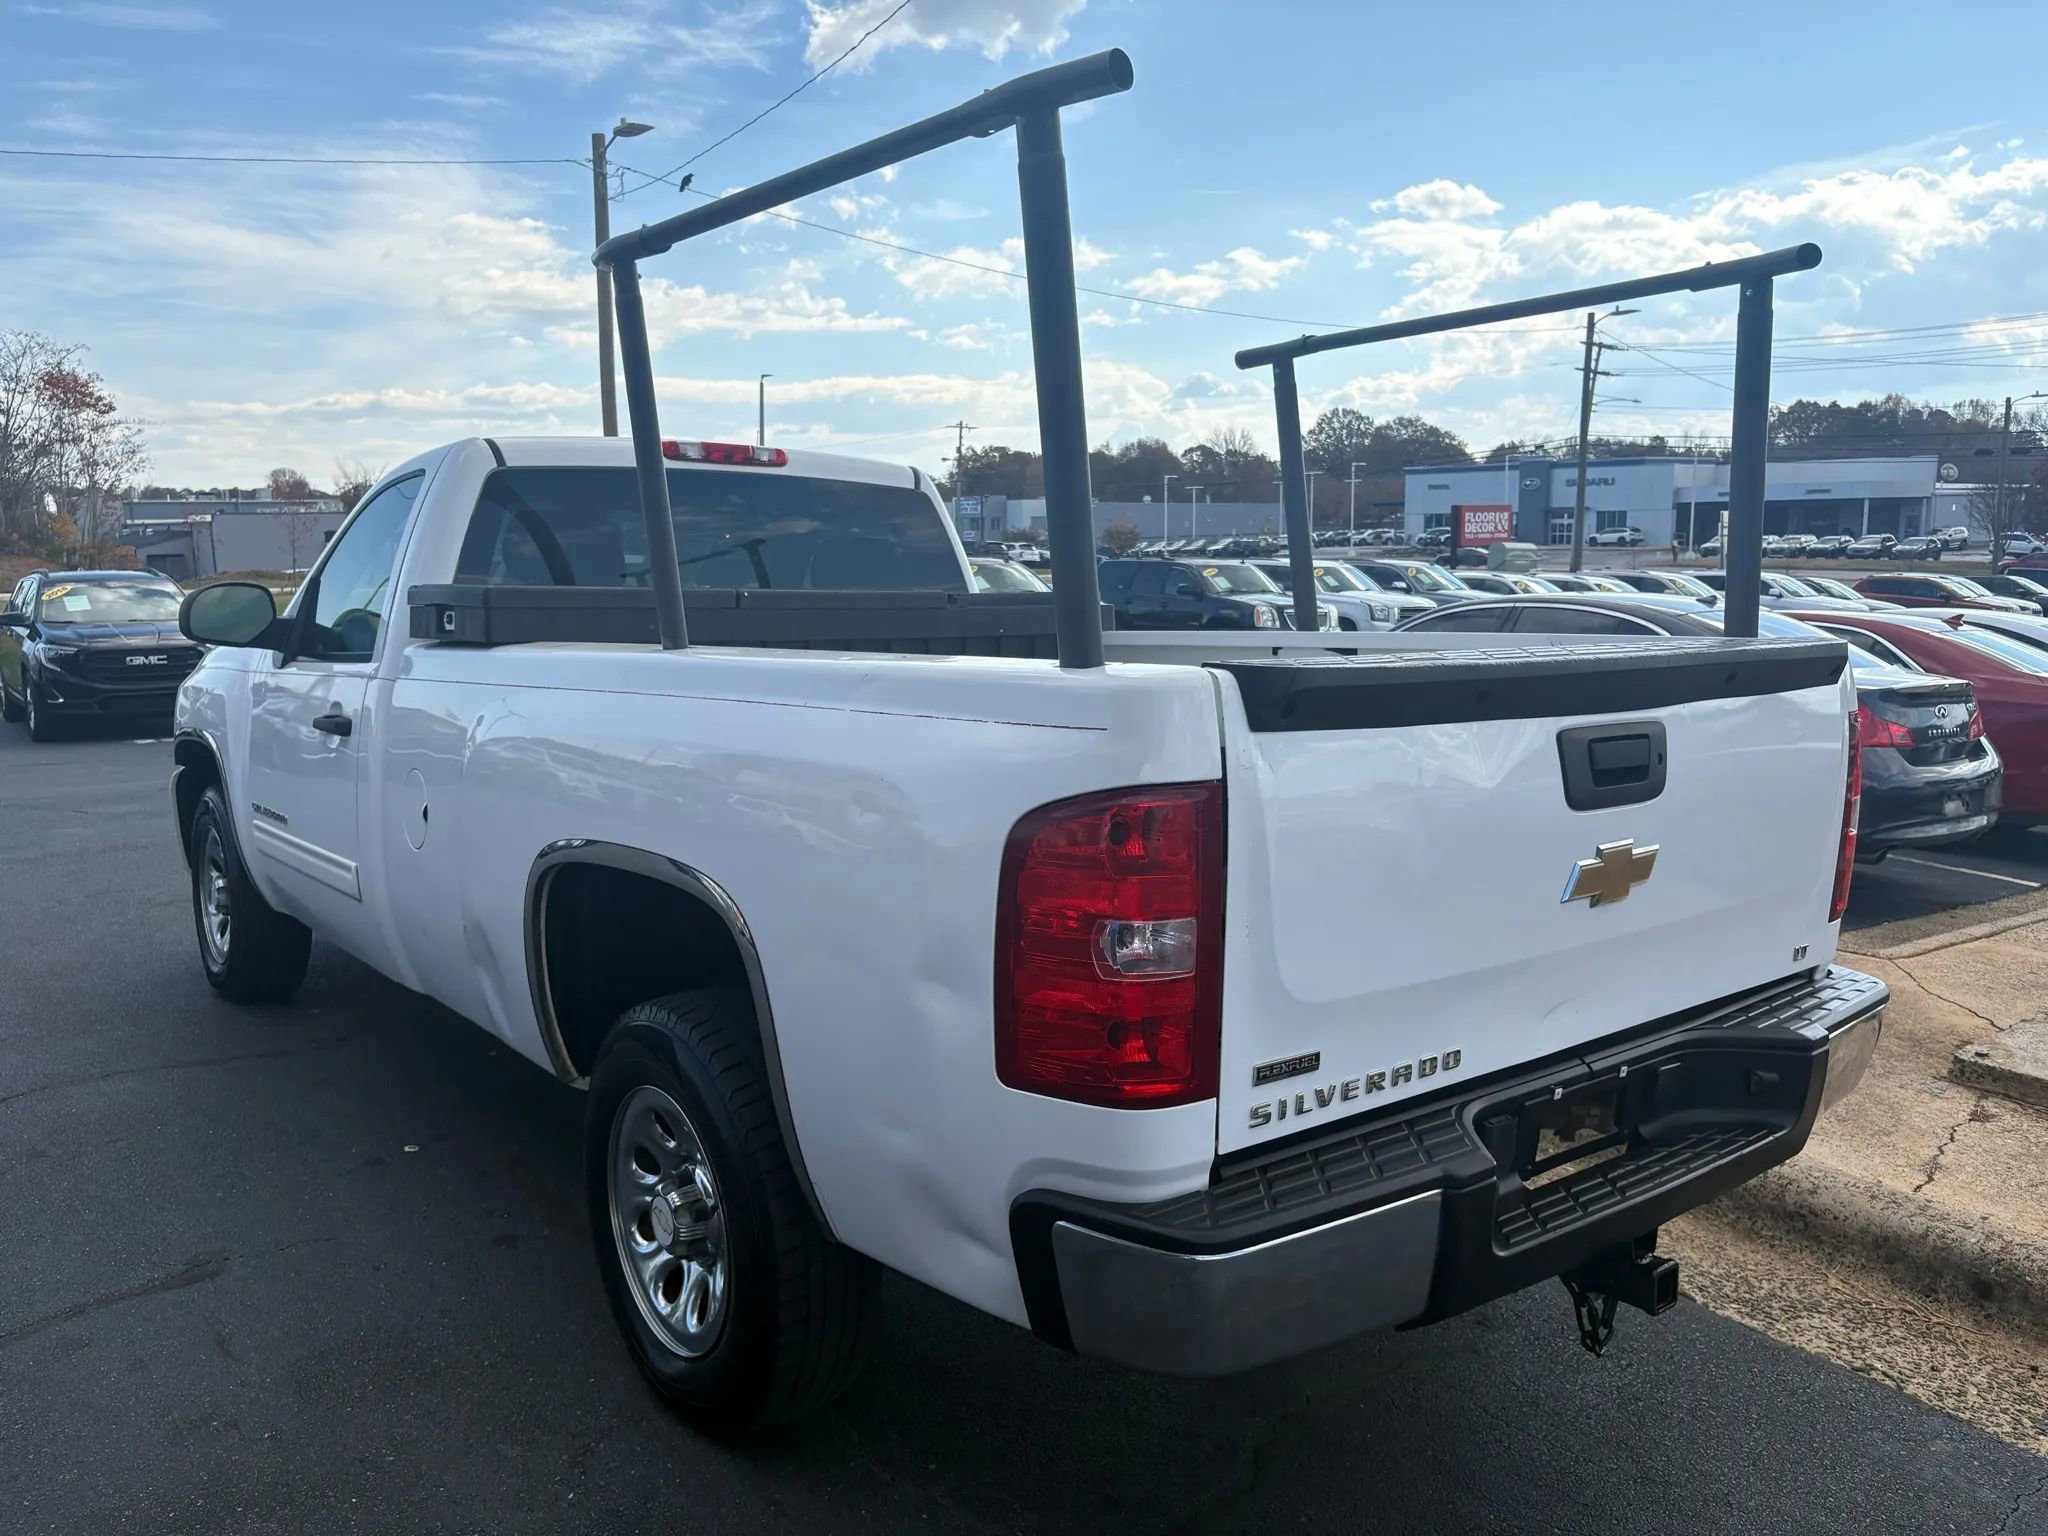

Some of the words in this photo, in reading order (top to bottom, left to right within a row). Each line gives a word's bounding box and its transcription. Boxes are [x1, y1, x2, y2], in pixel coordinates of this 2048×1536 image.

[1465, 512, 1496, 522] FLOOR
[1465, 522, 1496, 533] DECOR
[126, 655, 167, 665] GMC
[1258, 1053, 1320, 1080] FLEXFUEL
[1249, 1048, 1462, 1129] SILVERADO
